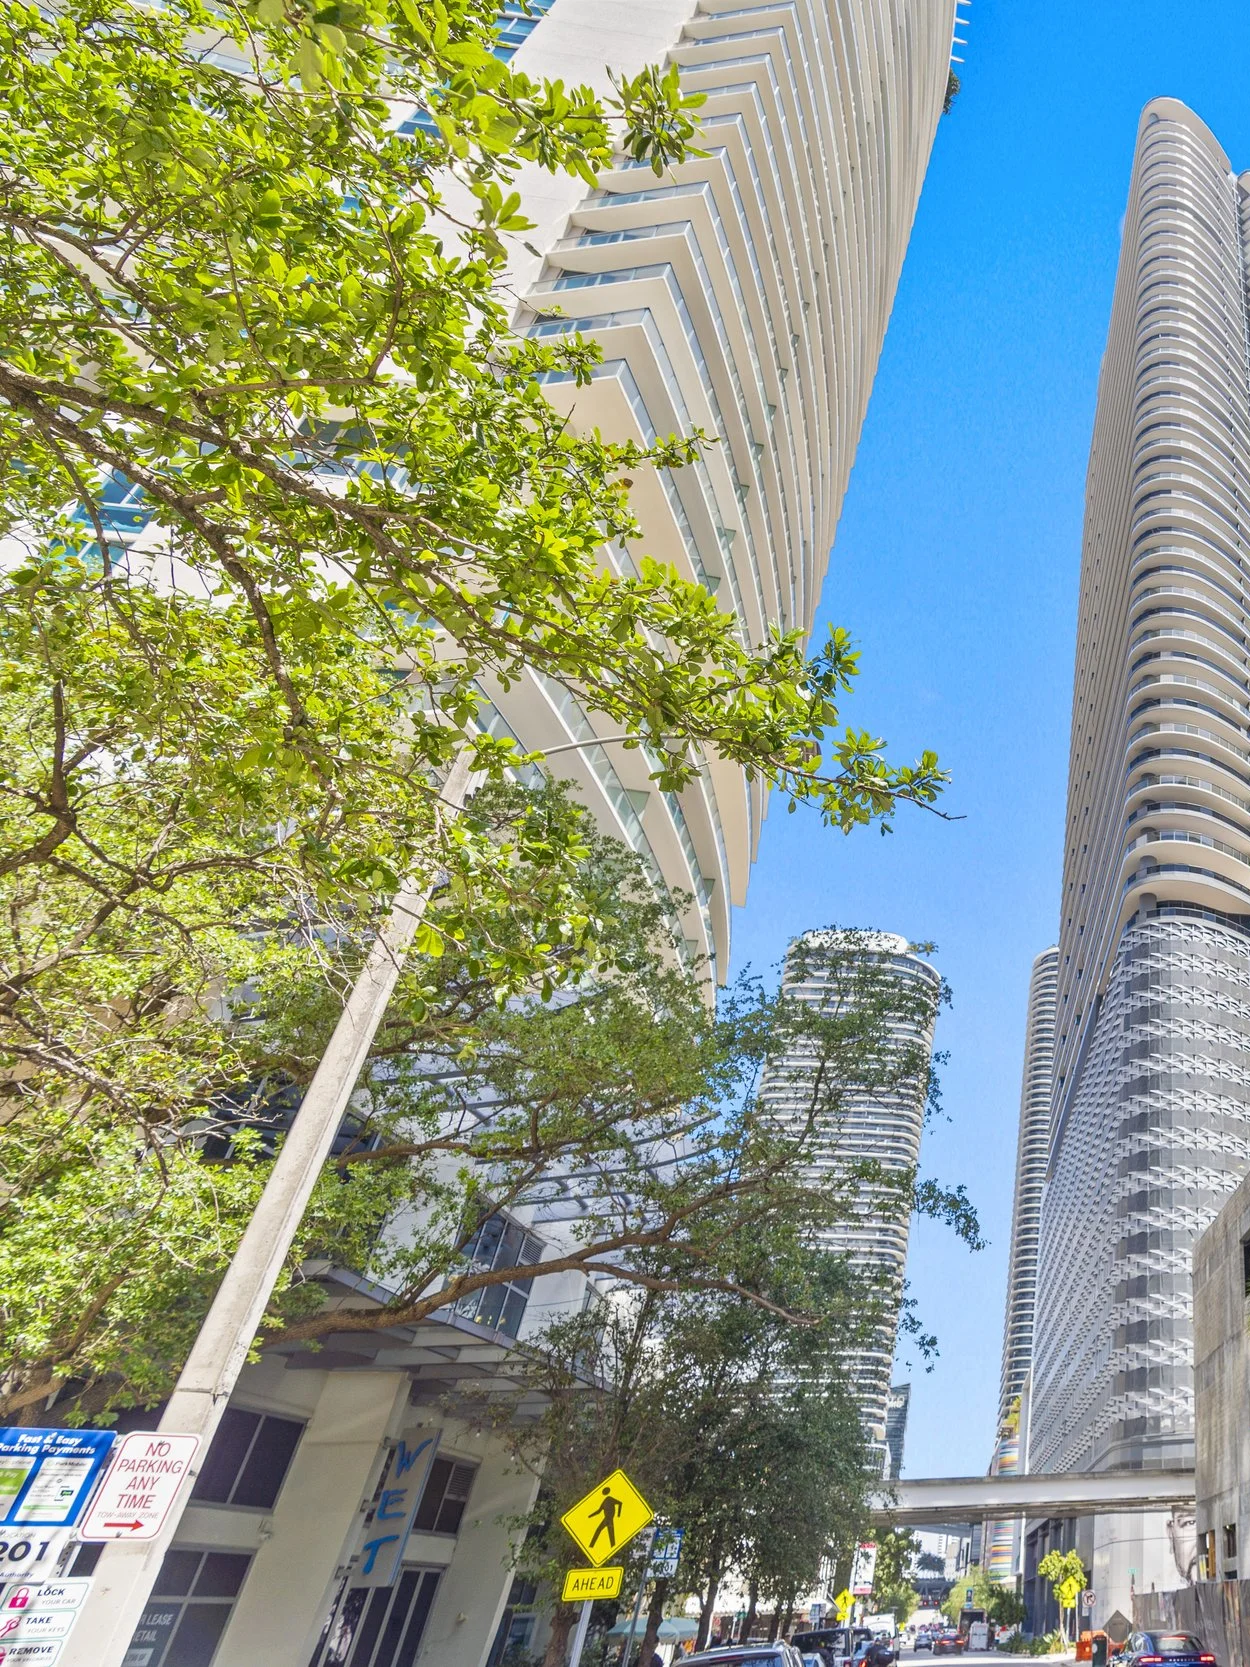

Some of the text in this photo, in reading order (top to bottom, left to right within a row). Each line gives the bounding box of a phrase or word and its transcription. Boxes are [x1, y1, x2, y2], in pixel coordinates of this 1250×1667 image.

[17, 1432, 83, 1447] Fast & Easy
[41, 1445, 96, 1455] Payments
[145, 1442, 171, 1457] NO
[117, 1459, 183, 1473] PARKING
[126, 1476, 160, 1490] ANY
[116, 1494, 156, 1509] TIME
[97, 1511, 136, 1519] TOW-AWAY
[572, 1576, 614, 1591] AHEAD
[37, 1588, 65, 1597] LOCK
[25, 1616, 53, 1625] TAKE
[146, 1614, 174, 1625] LEASE
[8, 1646, 54, 1655] REMOVE
